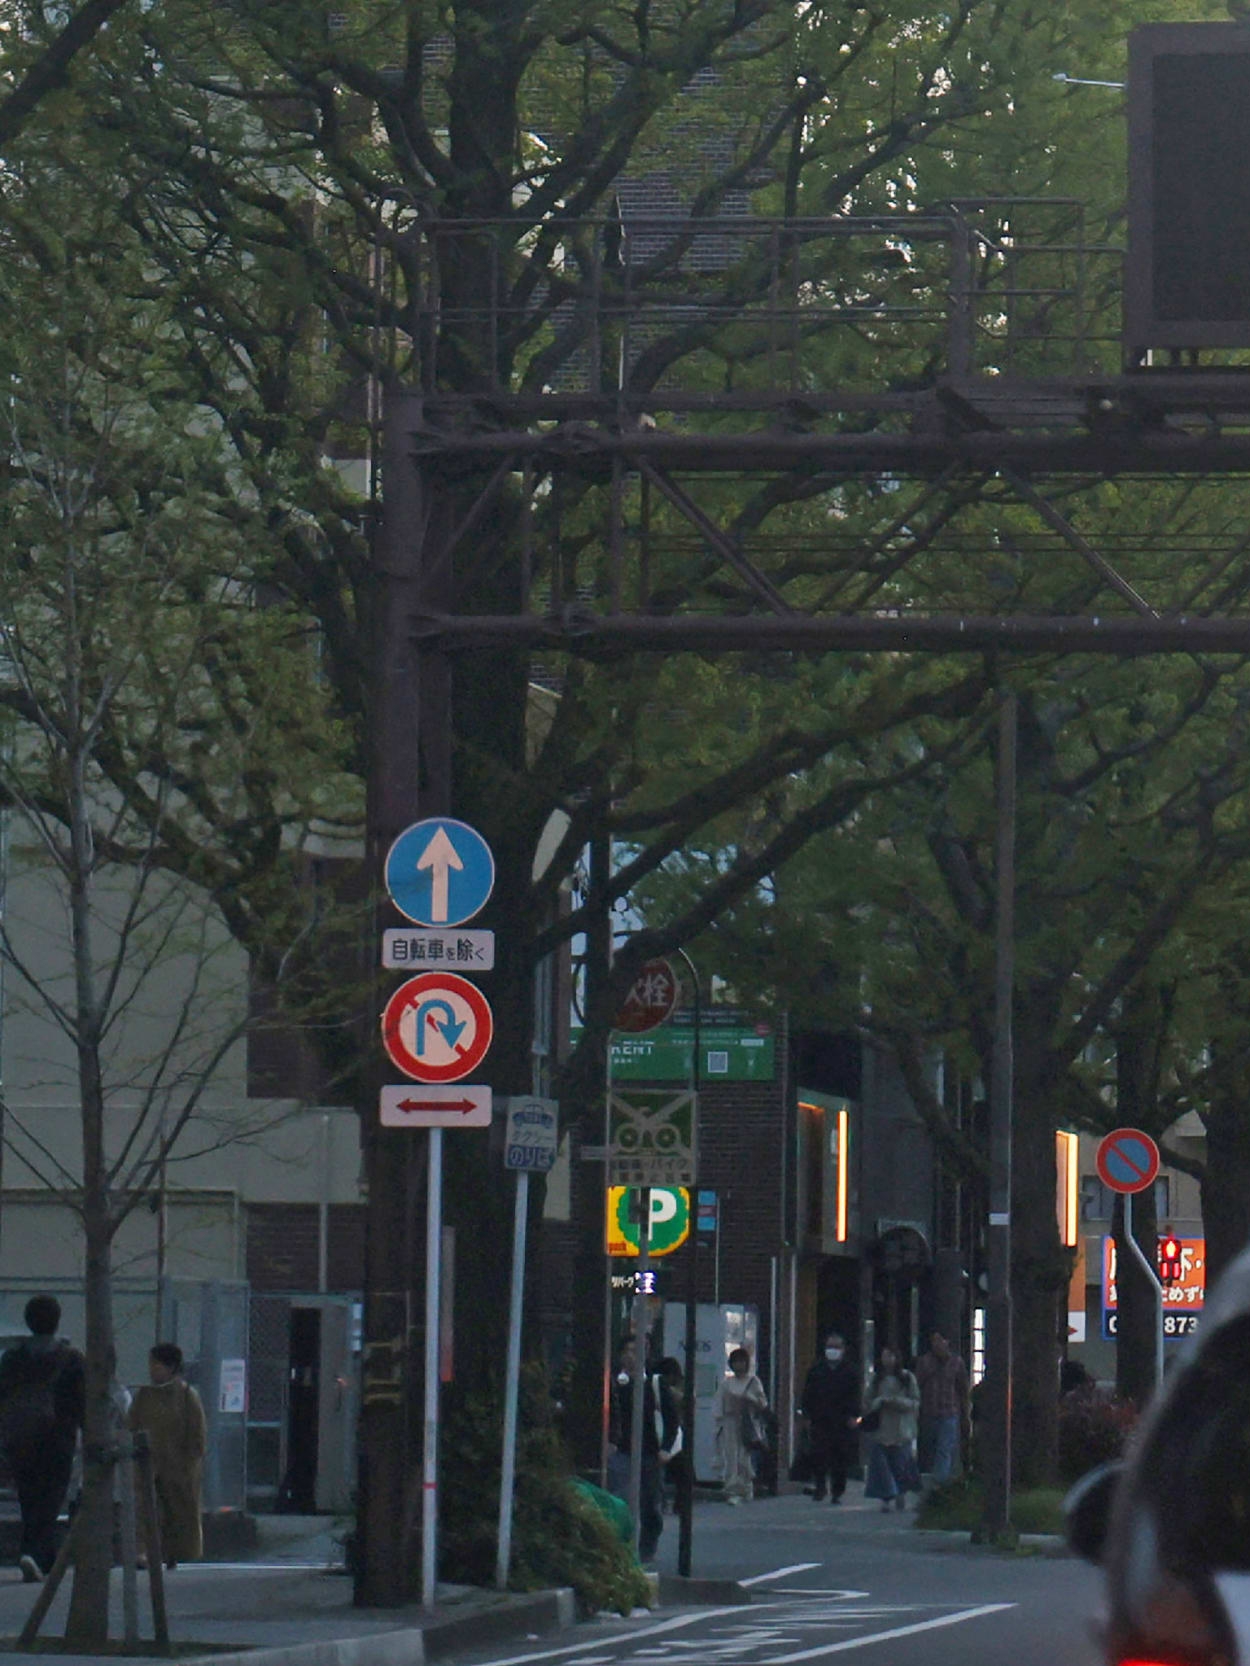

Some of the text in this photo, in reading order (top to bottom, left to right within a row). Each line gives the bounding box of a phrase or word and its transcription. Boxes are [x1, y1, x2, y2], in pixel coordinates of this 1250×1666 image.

[392, 938, 485, 961] 自転車を除く
[638, 1187, 677, 1241] P
